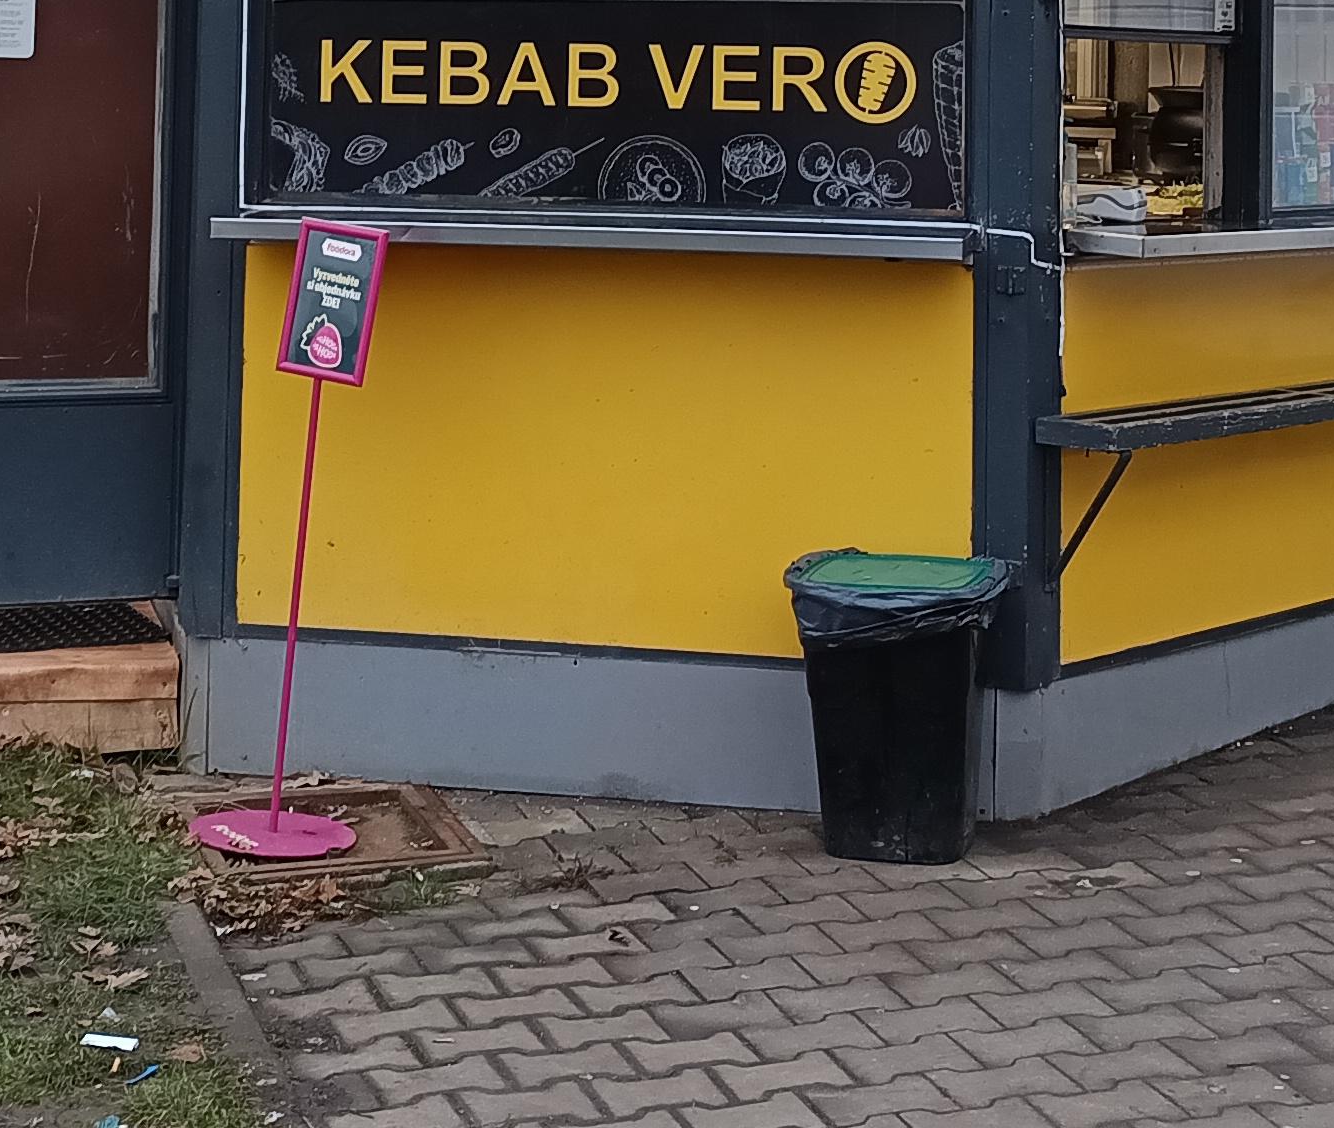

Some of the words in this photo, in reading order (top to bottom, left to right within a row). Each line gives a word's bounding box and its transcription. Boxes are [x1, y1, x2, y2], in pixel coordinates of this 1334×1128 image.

[319, 38, 620, 108] KEBAB
[648, 40, 918, 124] VERO
[327, 243, 356, 256] foodora
